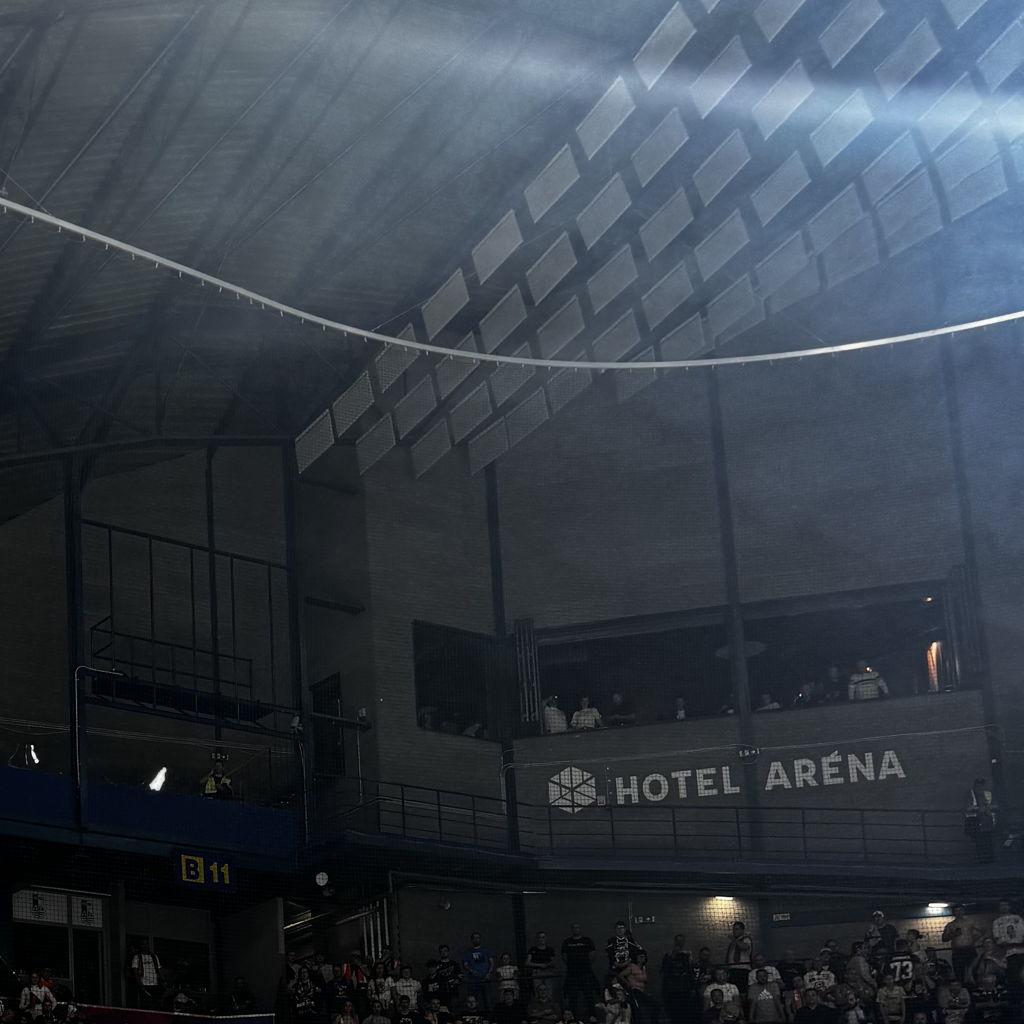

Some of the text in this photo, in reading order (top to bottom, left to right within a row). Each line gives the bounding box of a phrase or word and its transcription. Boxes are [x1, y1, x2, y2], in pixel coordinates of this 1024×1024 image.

[616, 749, 906, 805] HOTEL ARÉNA
[210, 862, 230, 884] 11
[889, 960, 914, 982] 73
